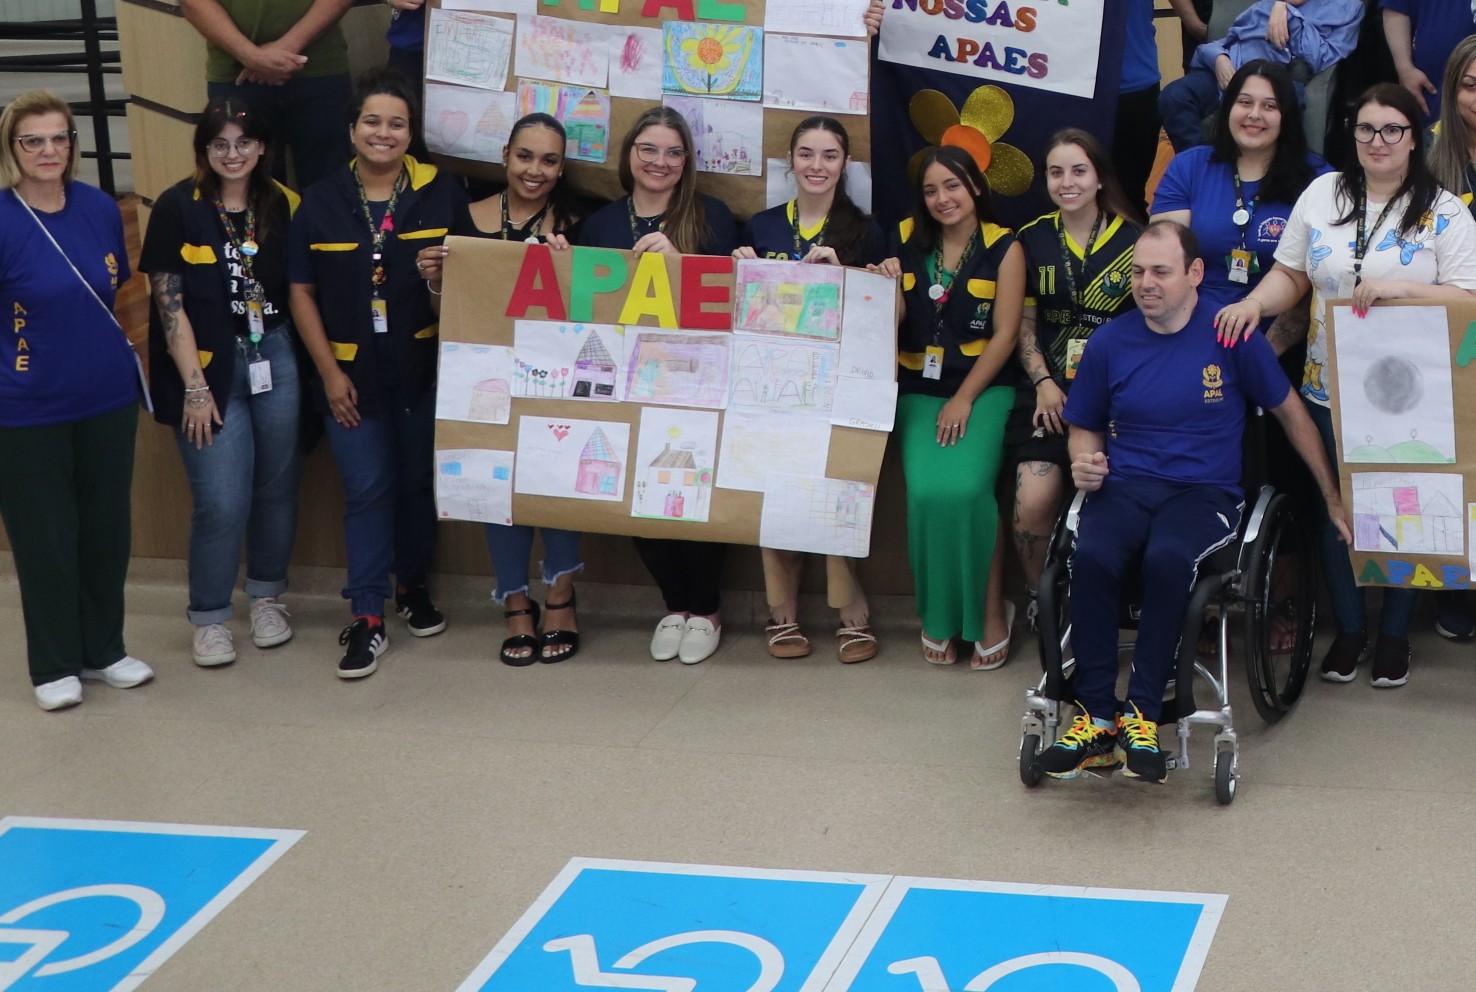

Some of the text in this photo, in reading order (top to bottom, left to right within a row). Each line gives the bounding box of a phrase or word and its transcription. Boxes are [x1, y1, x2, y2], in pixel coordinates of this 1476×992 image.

[928, 34, 1048, 79] APAES
[505, 244, 733, 330] APAE
[1039, 265, 1056, 295] 11
[1358, 559, 1471, 590] APAE
